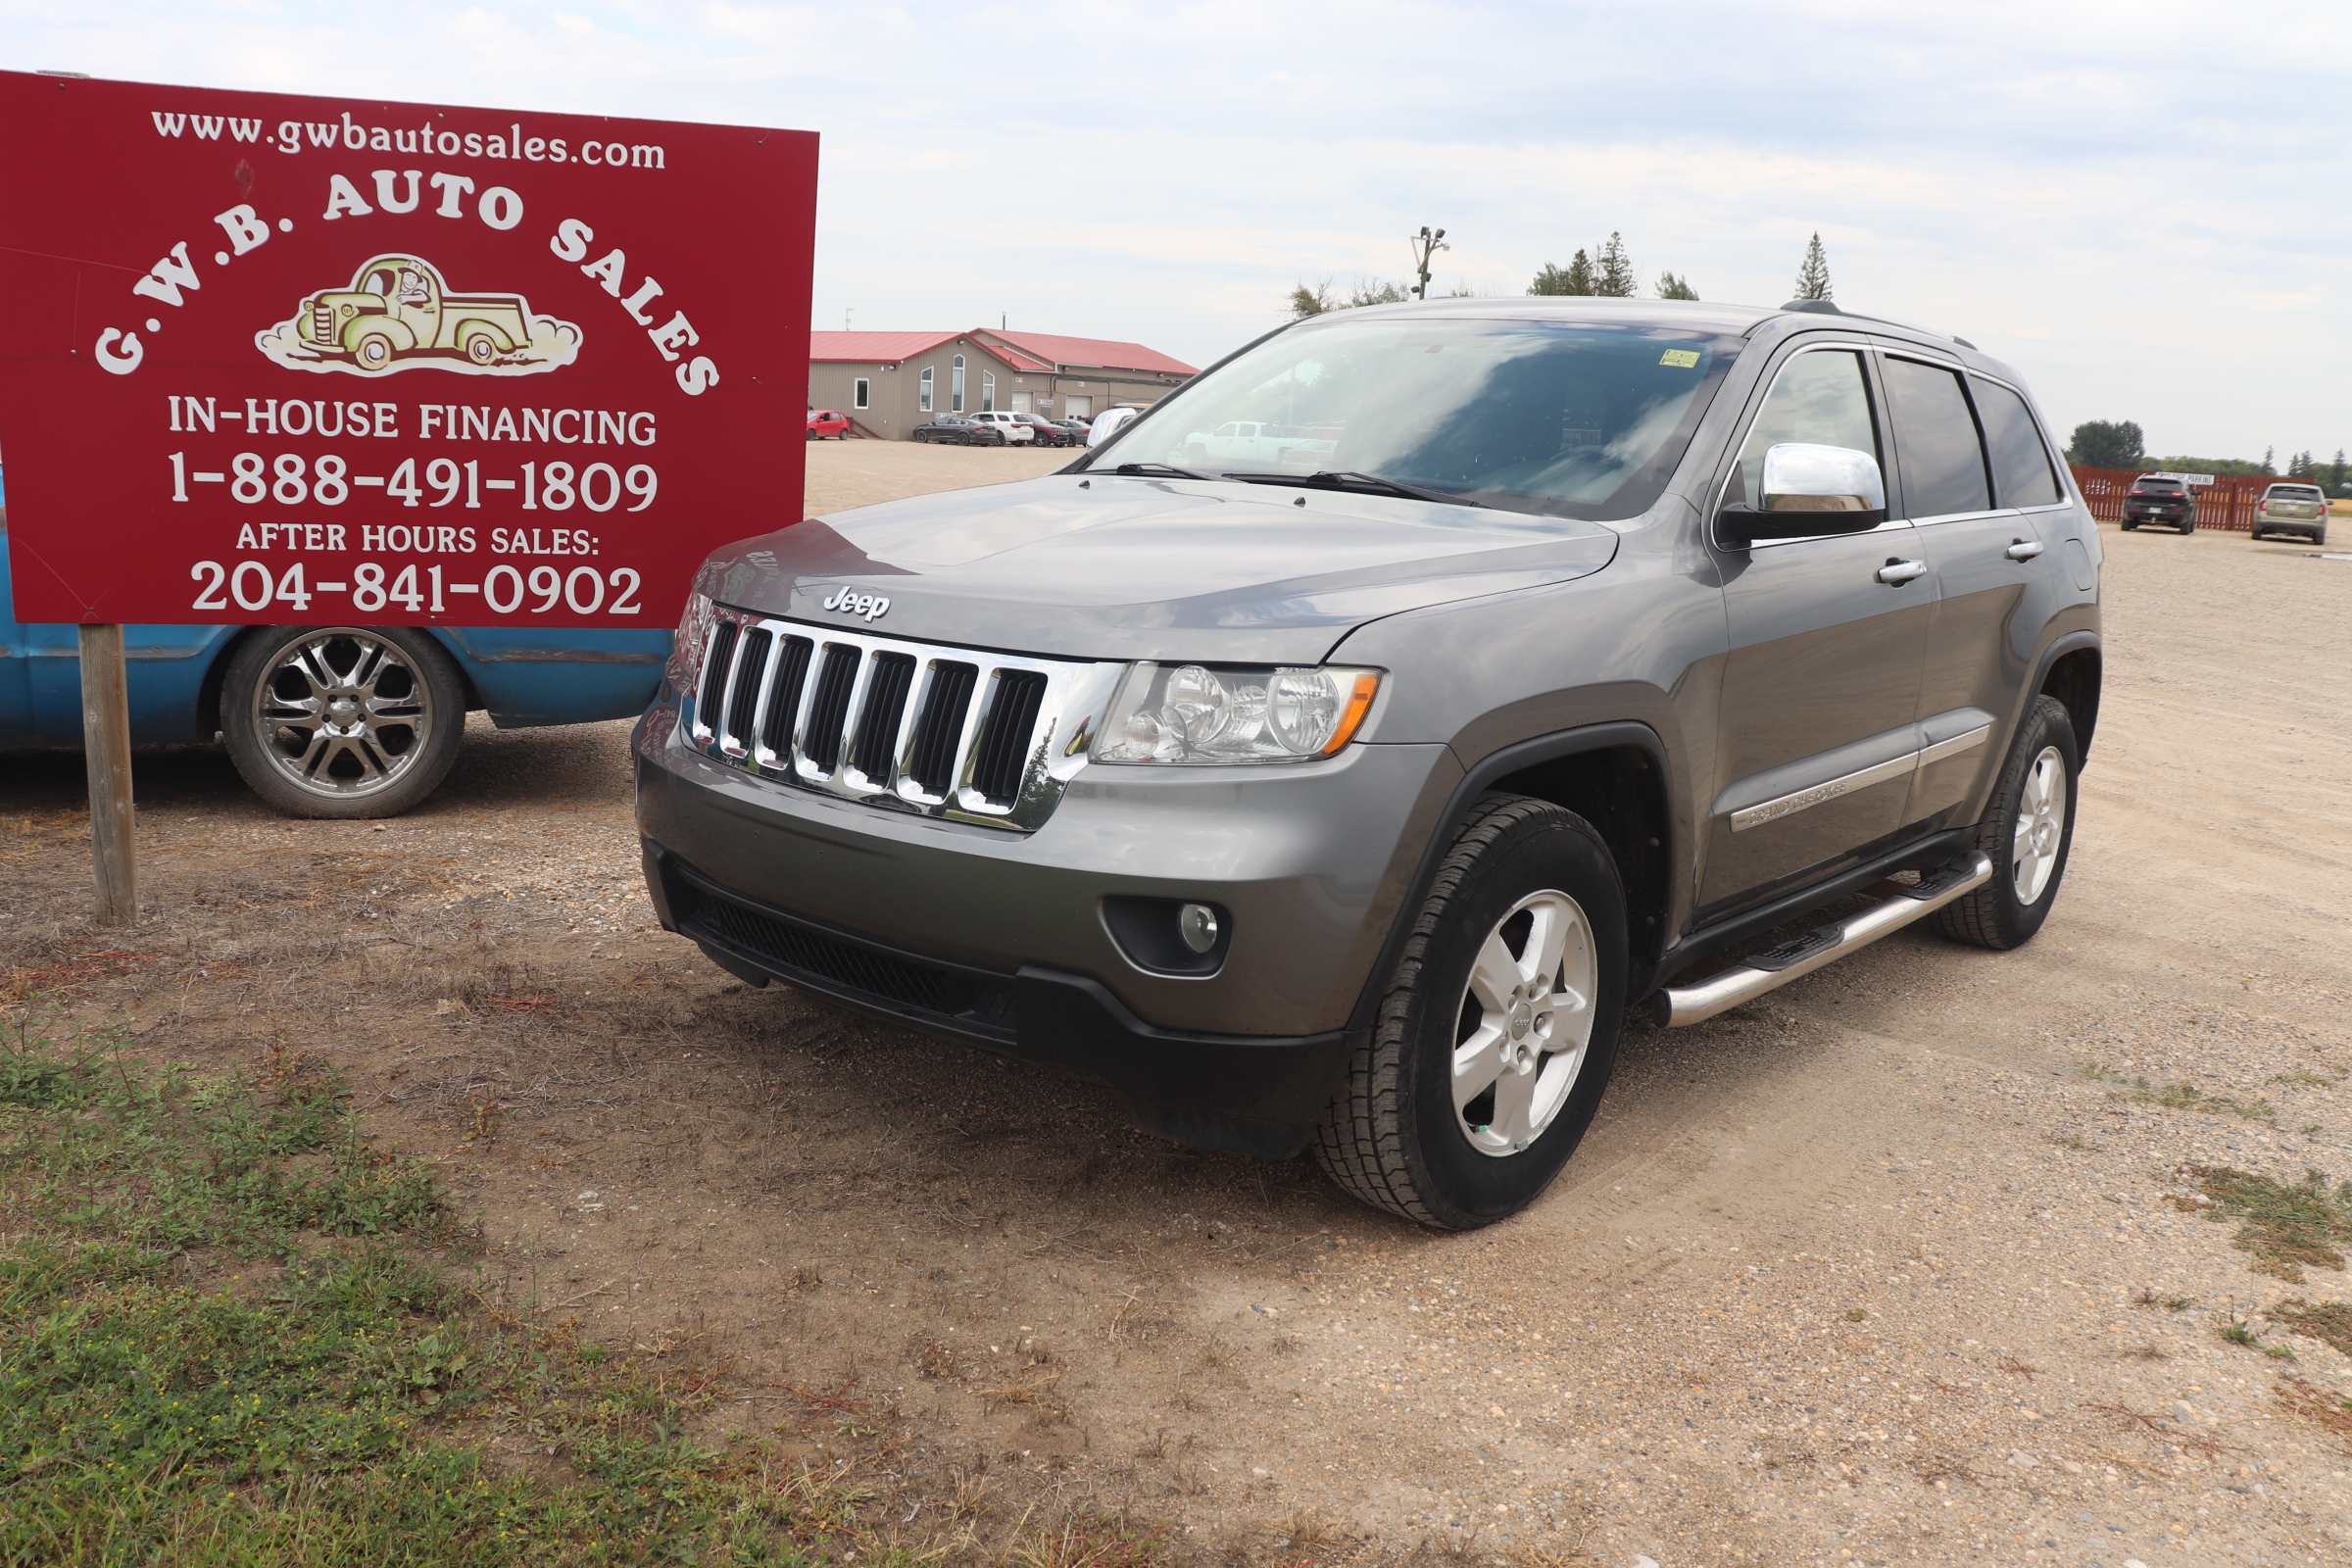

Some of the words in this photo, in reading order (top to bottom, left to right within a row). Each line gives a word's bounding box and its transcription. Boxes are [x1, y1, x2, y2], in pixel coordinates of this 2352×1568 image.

[150, 111, 665, 170] www.gwbautosales.com
[94, 203, 294, 375] G.W.B.
[323, 170, 524, 231] AUTO
[550, 218, 720, 396] SALES
[168, 395, 399, 438] IN-HOUSE
[418, 404, 657, 447] FINANCING
[168, 451, 659, 513] 1-888-491-1809
[235, 522, 347, 551] AFTER
[361, 524, 477, 554] HOURS
[490, 527, 600, 556] SALES:
[190, 560, 642, 615] 204-841-0902
[823, 585, 891, 623] Jeep
[1749, 801, 1790, 825] GRAND
[1792, 782, 1846, 809] CHEROKEE
